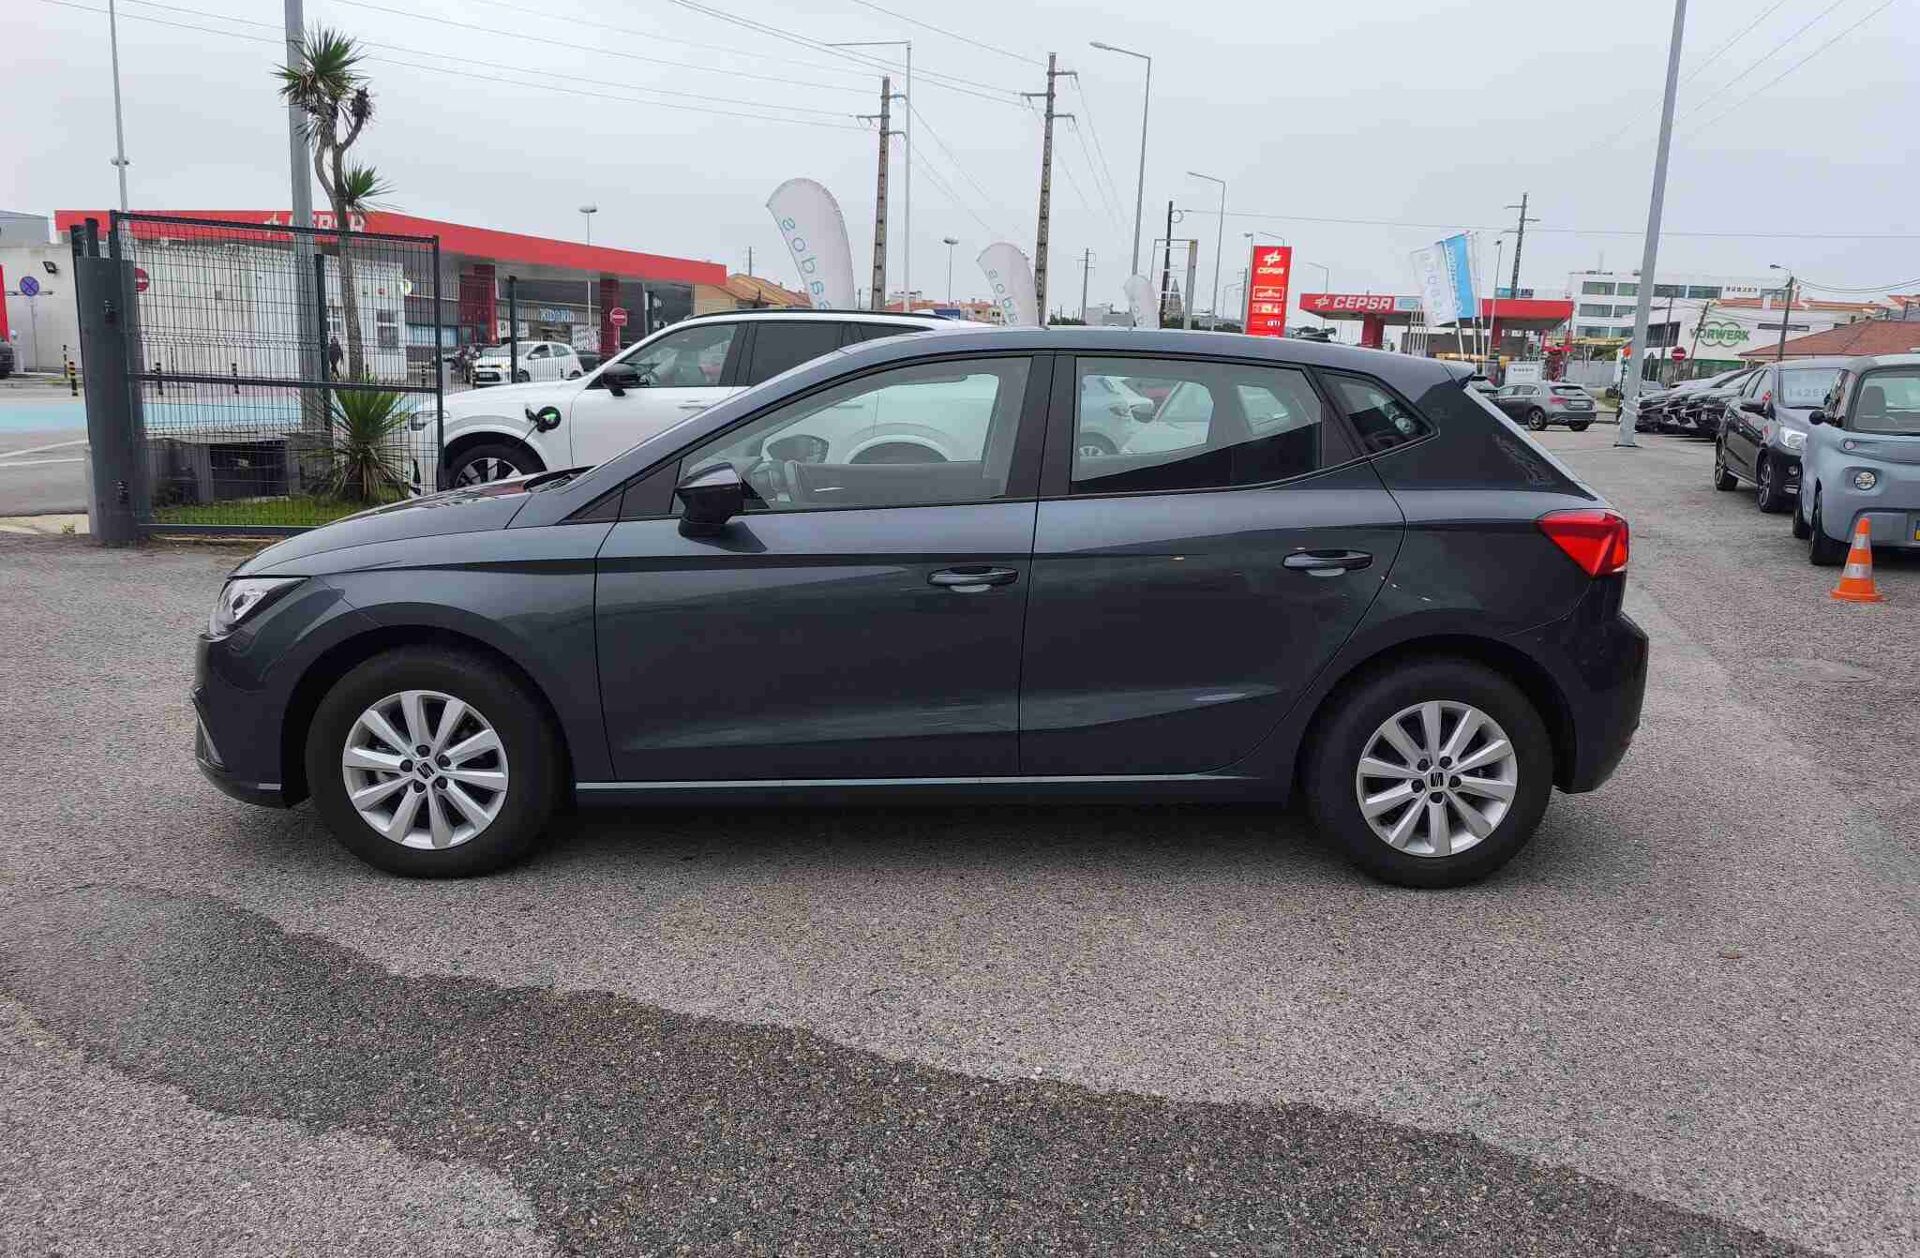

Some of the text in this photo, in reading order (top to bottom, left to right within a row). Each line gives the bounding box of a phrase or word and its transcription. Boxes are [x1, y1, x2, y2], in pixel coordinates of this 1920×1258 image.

[1257, 267, 1284, 275] CEPSA
[1333, 296, 1392, 310] CEPSA
[1690, 328, 1750, 341] VORWERK
